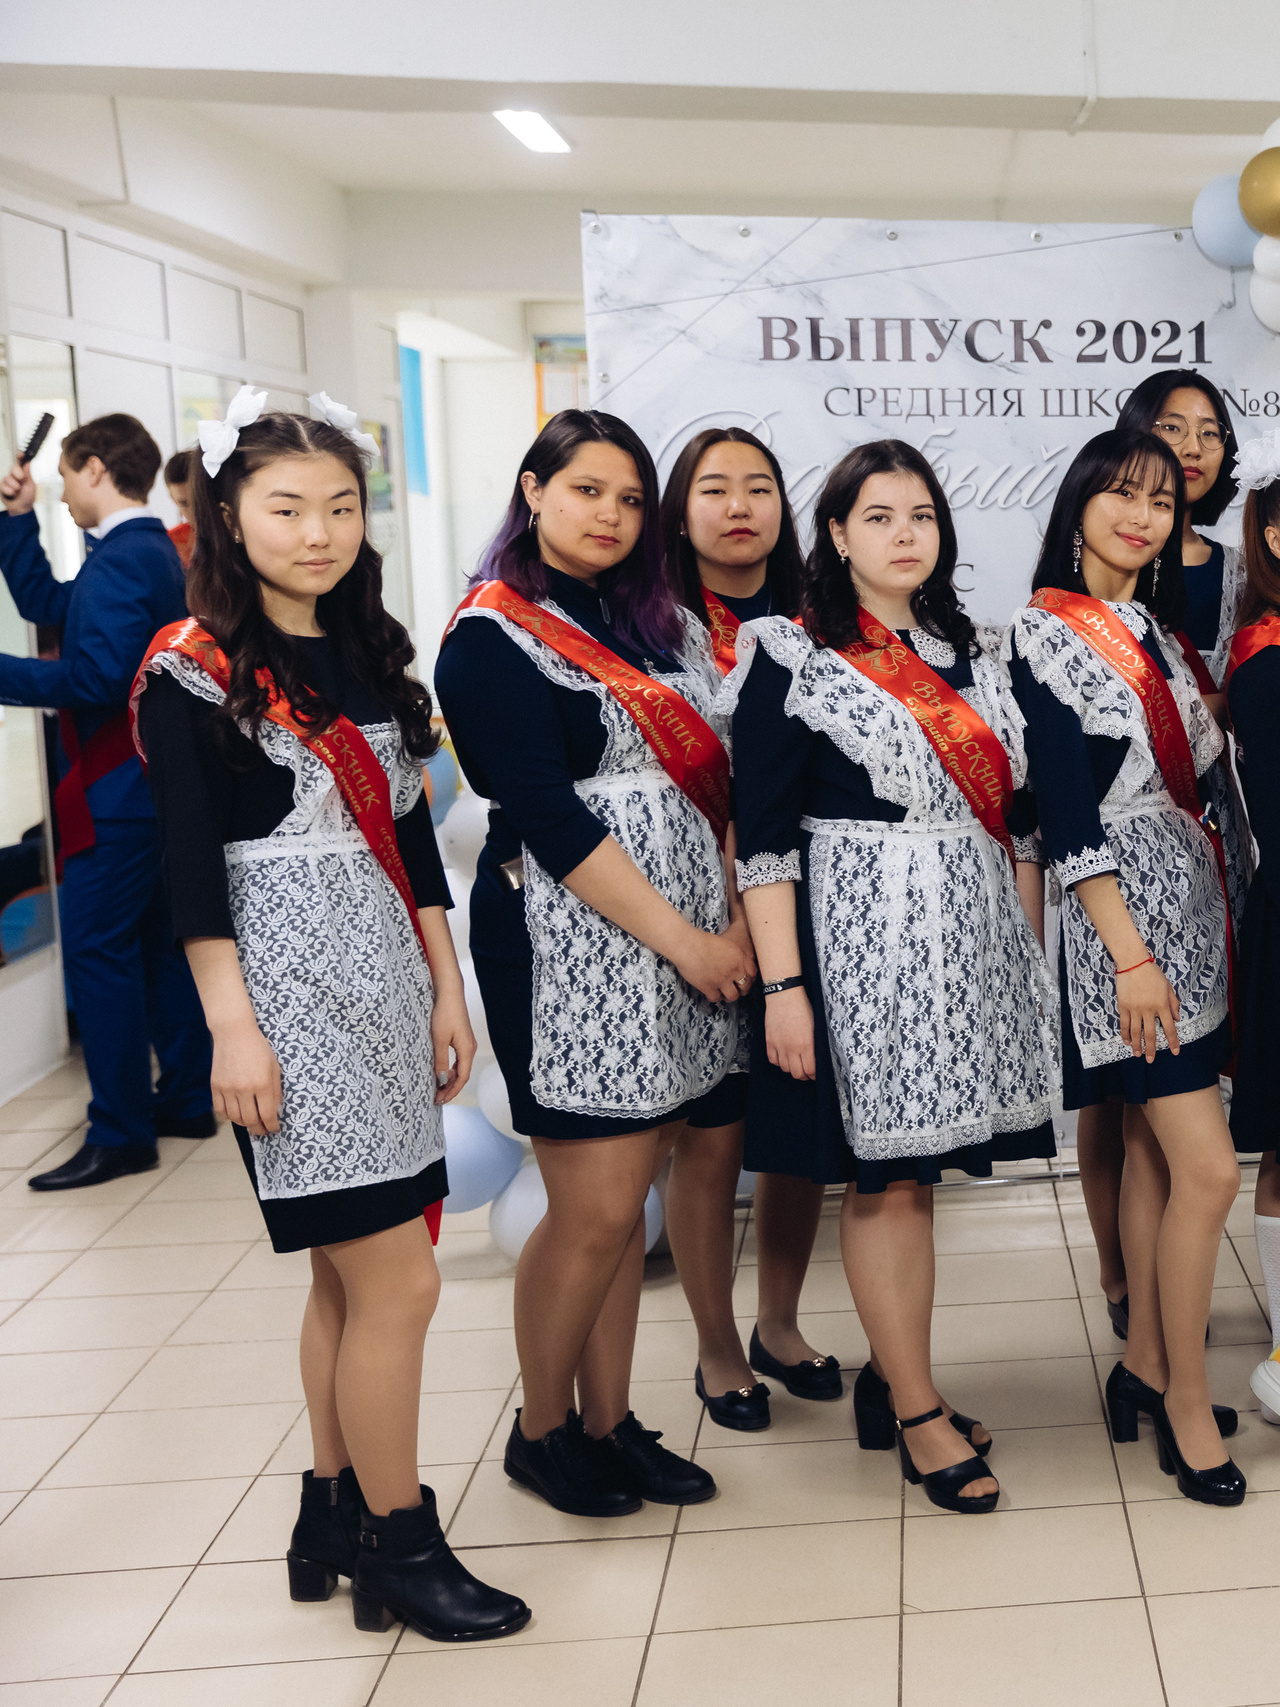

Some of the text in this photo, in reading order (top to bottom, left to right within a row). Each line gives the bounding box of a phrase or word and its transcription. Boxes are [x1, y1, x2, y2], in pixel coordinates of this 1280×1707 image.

[757, 314, 1213, 366] ВЫПУСК 2021
[823, 386, 1024, 424] СРЕДНЯЯ
[1222, 387, 1280, 418] №8
[578, 643, 702, 765] Выпускник
[1084, 610, 1173, 748] Выпускник
[629, 701, 673, 760] Вероника
[912, 680, 1006, 809] Выпускник
[945, 751, 986, 812] Кристина
